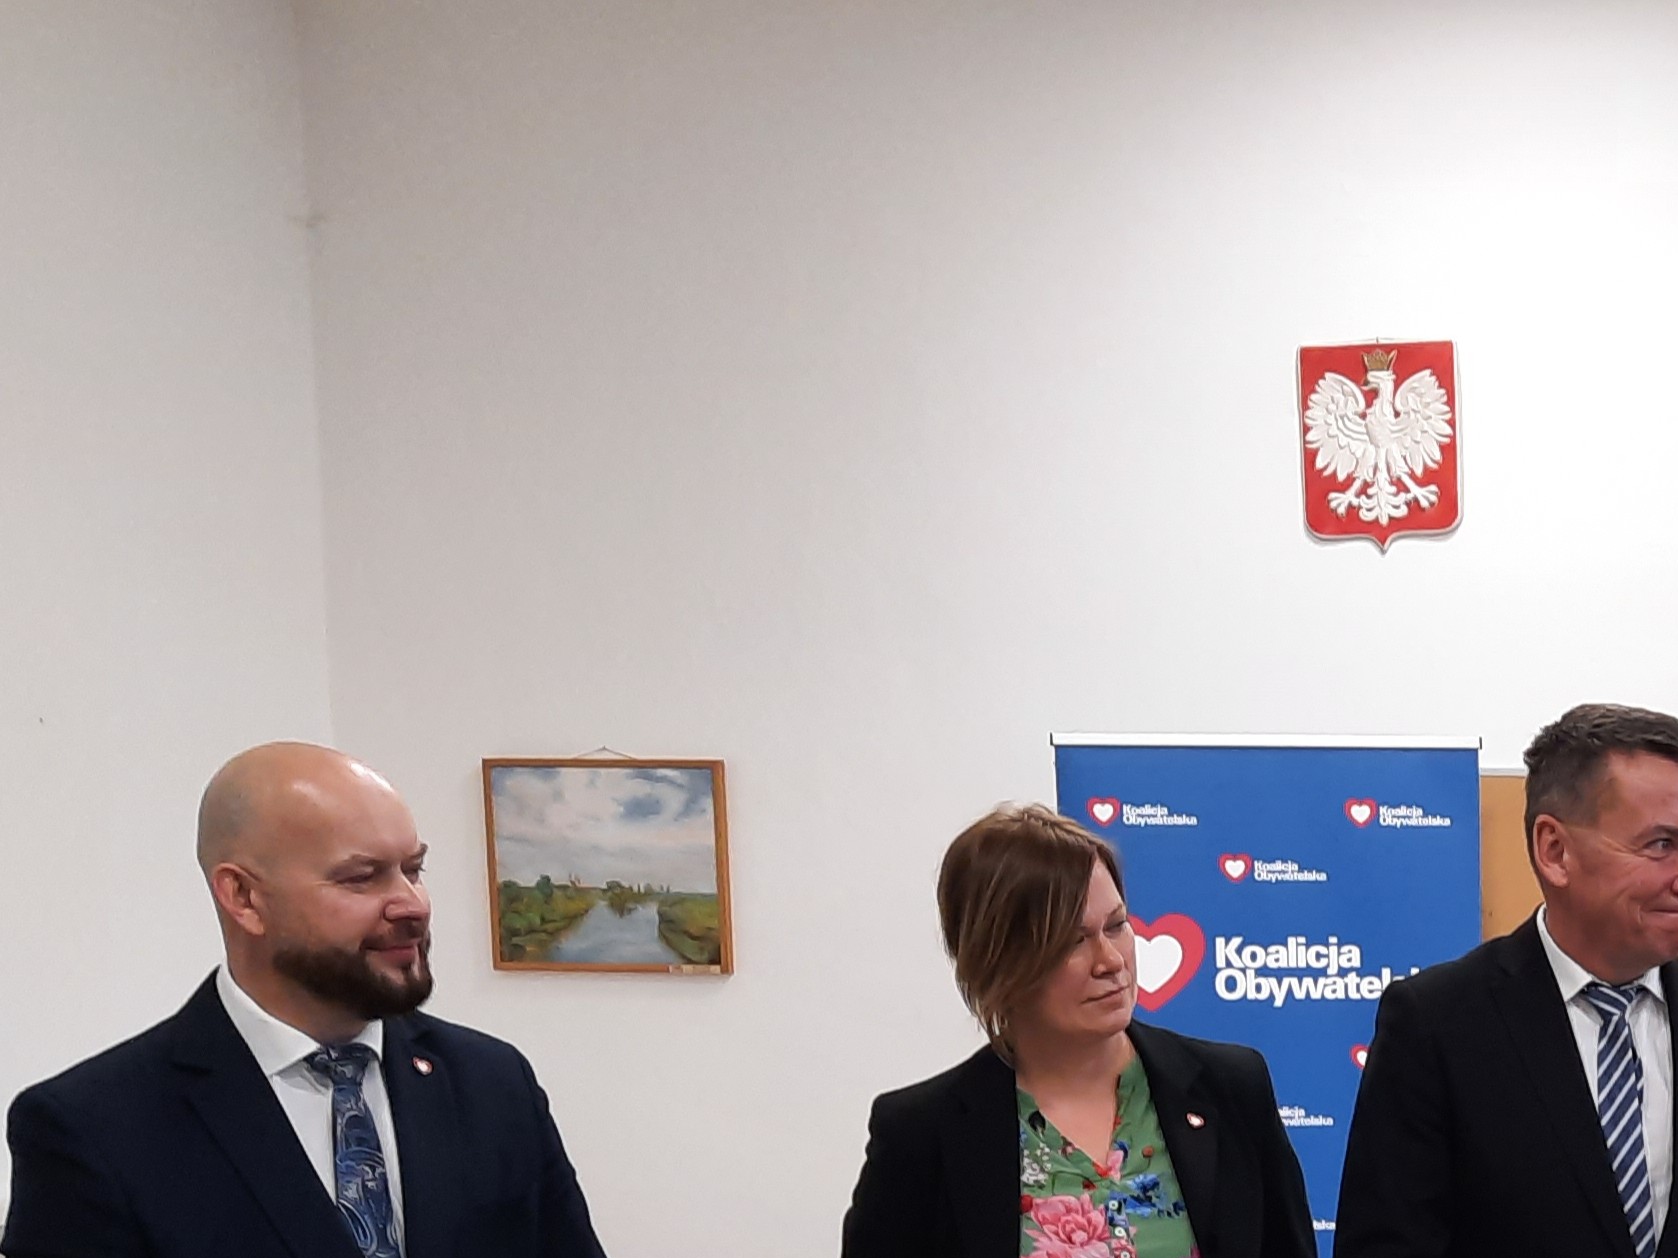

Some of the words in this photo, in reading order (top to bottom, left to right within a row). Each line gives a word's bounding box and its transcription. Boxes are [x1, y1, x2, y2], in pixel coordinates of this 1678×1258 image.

[1123, 803, 1168, 818] Koalicja
[1379, 805, 1423, 819] Koalicja
[1123, 814, 1198, 827] Obywatelska
[1379, 816, 1451, 829] Obywatelska
[1254, 860, 1298, 874] Koalicja
[1254, 870, 1327, 884] Obywatelska
[1215, 937, 1361, 975] Koalicja
[1215, 967, 1420, 1006] Obywatel
